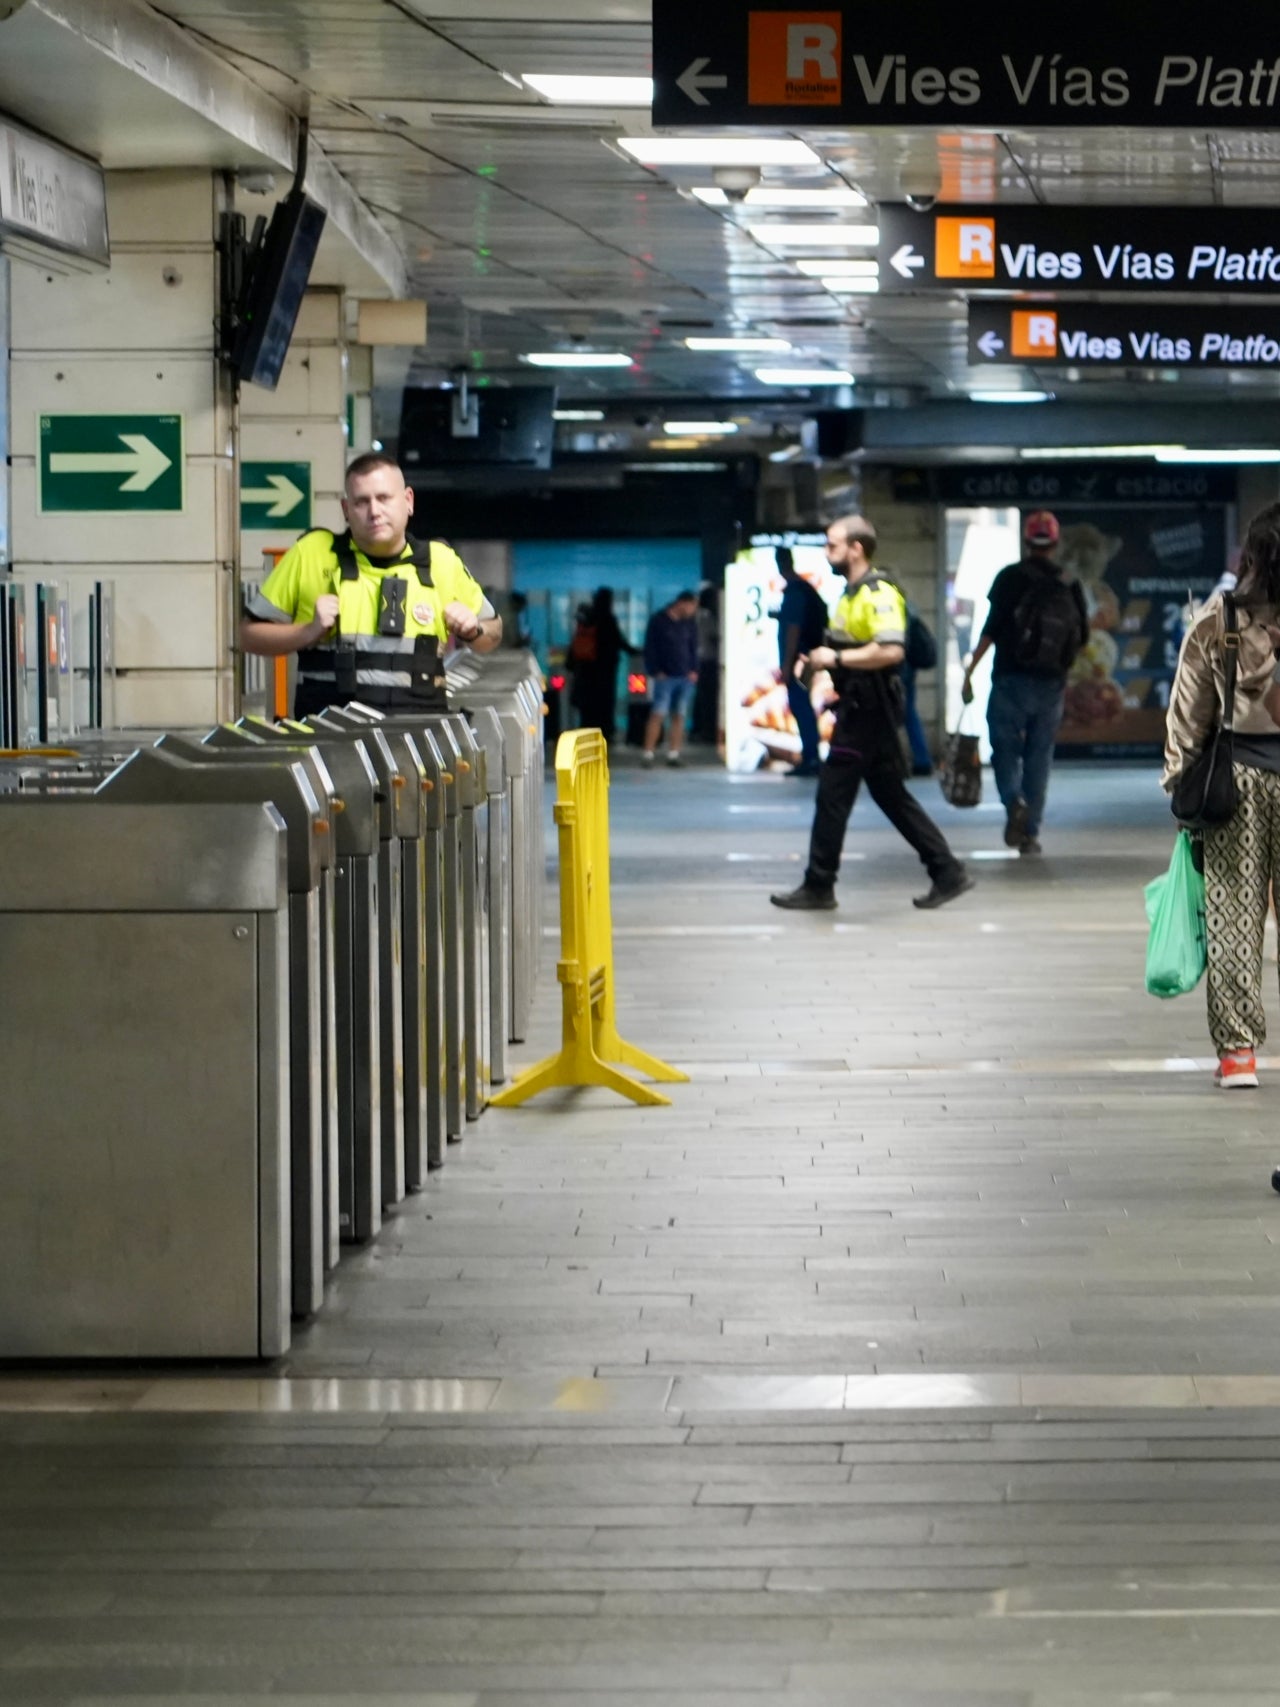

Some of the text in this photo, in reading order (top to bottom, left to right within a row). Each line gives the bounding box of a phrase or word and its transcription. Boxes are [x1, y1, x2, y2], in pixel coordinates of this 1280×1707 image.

[786, 22, 839, 79] R
[853, 54, 981, 106] Vies
[1002, 53, 1130, 106] Vías
[959, 224, 994, 263] R
[1001, 243, 1082, 279] Vies
[1093, 243, 1175, 280] Vías
[1027, 316, 1056, 347] R
[1059, 330, 1122, 360] Vies
[1128, 331, 1192, 361] Vías
